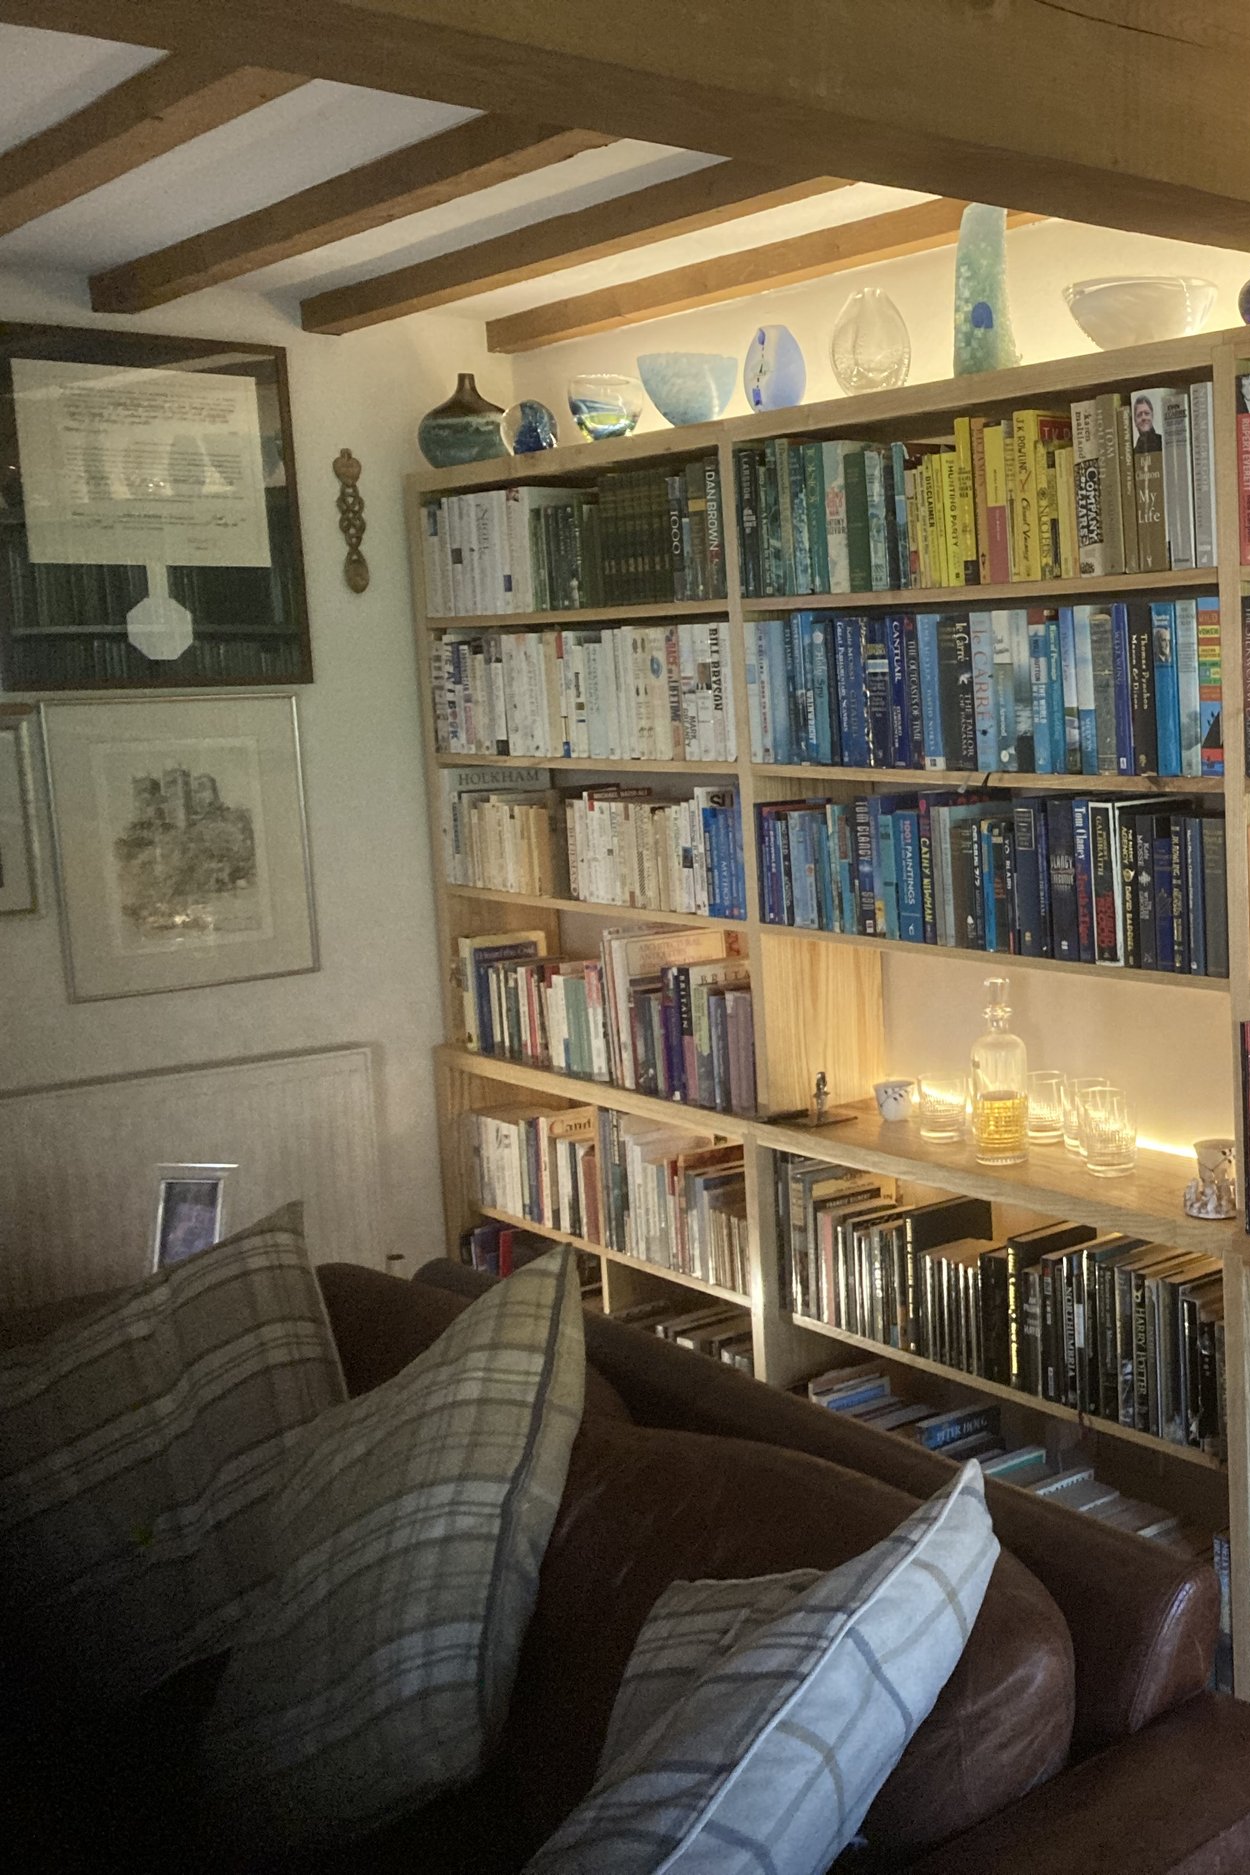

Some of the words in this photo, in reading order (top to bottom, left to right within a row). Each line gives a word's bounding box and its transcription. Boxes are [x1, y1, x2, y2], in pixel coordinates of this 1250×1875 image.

[1242, 418, 1250, 454] RUPERT
[706, 470, 716, 500] DAN
[925, 476, 935, 527] DISCLAIMER
[947, 465, 957, 512] HUNTING
[1085, 468, 1099, 541] COMPANY
[1137, 509, 1161, 525] Life
[707, 504, 719, 552] BROWN
[950, 514, 959, 547] PARTY
[708, 628, 719, 656] BILL
[892, 621, 902, 684] CANTUAR
[1140, 633, 1148, 670] Thomas
[709, 660, 723, 711] BRYSON
[965, 720, 974, 757] TAILOR
[458, 769, 540, 786] HOLKHAM
[904, 820, 912, 844] 1001
[1074, 806, 1086, 827] Tom
[857, 825, 871, 861] CLANCY
[920, 838, 930, 875] CATHY
[1120, 826, 1129, 865] AGENCY
[904, 845, 915, 904] PAINTINGS
[1065, 1286, 1076, 1377] NORTHUMBRIA
[1135, 1307, 1146, 1346] HARRY
[1136, 1351, 1147, 1395] POTTER
